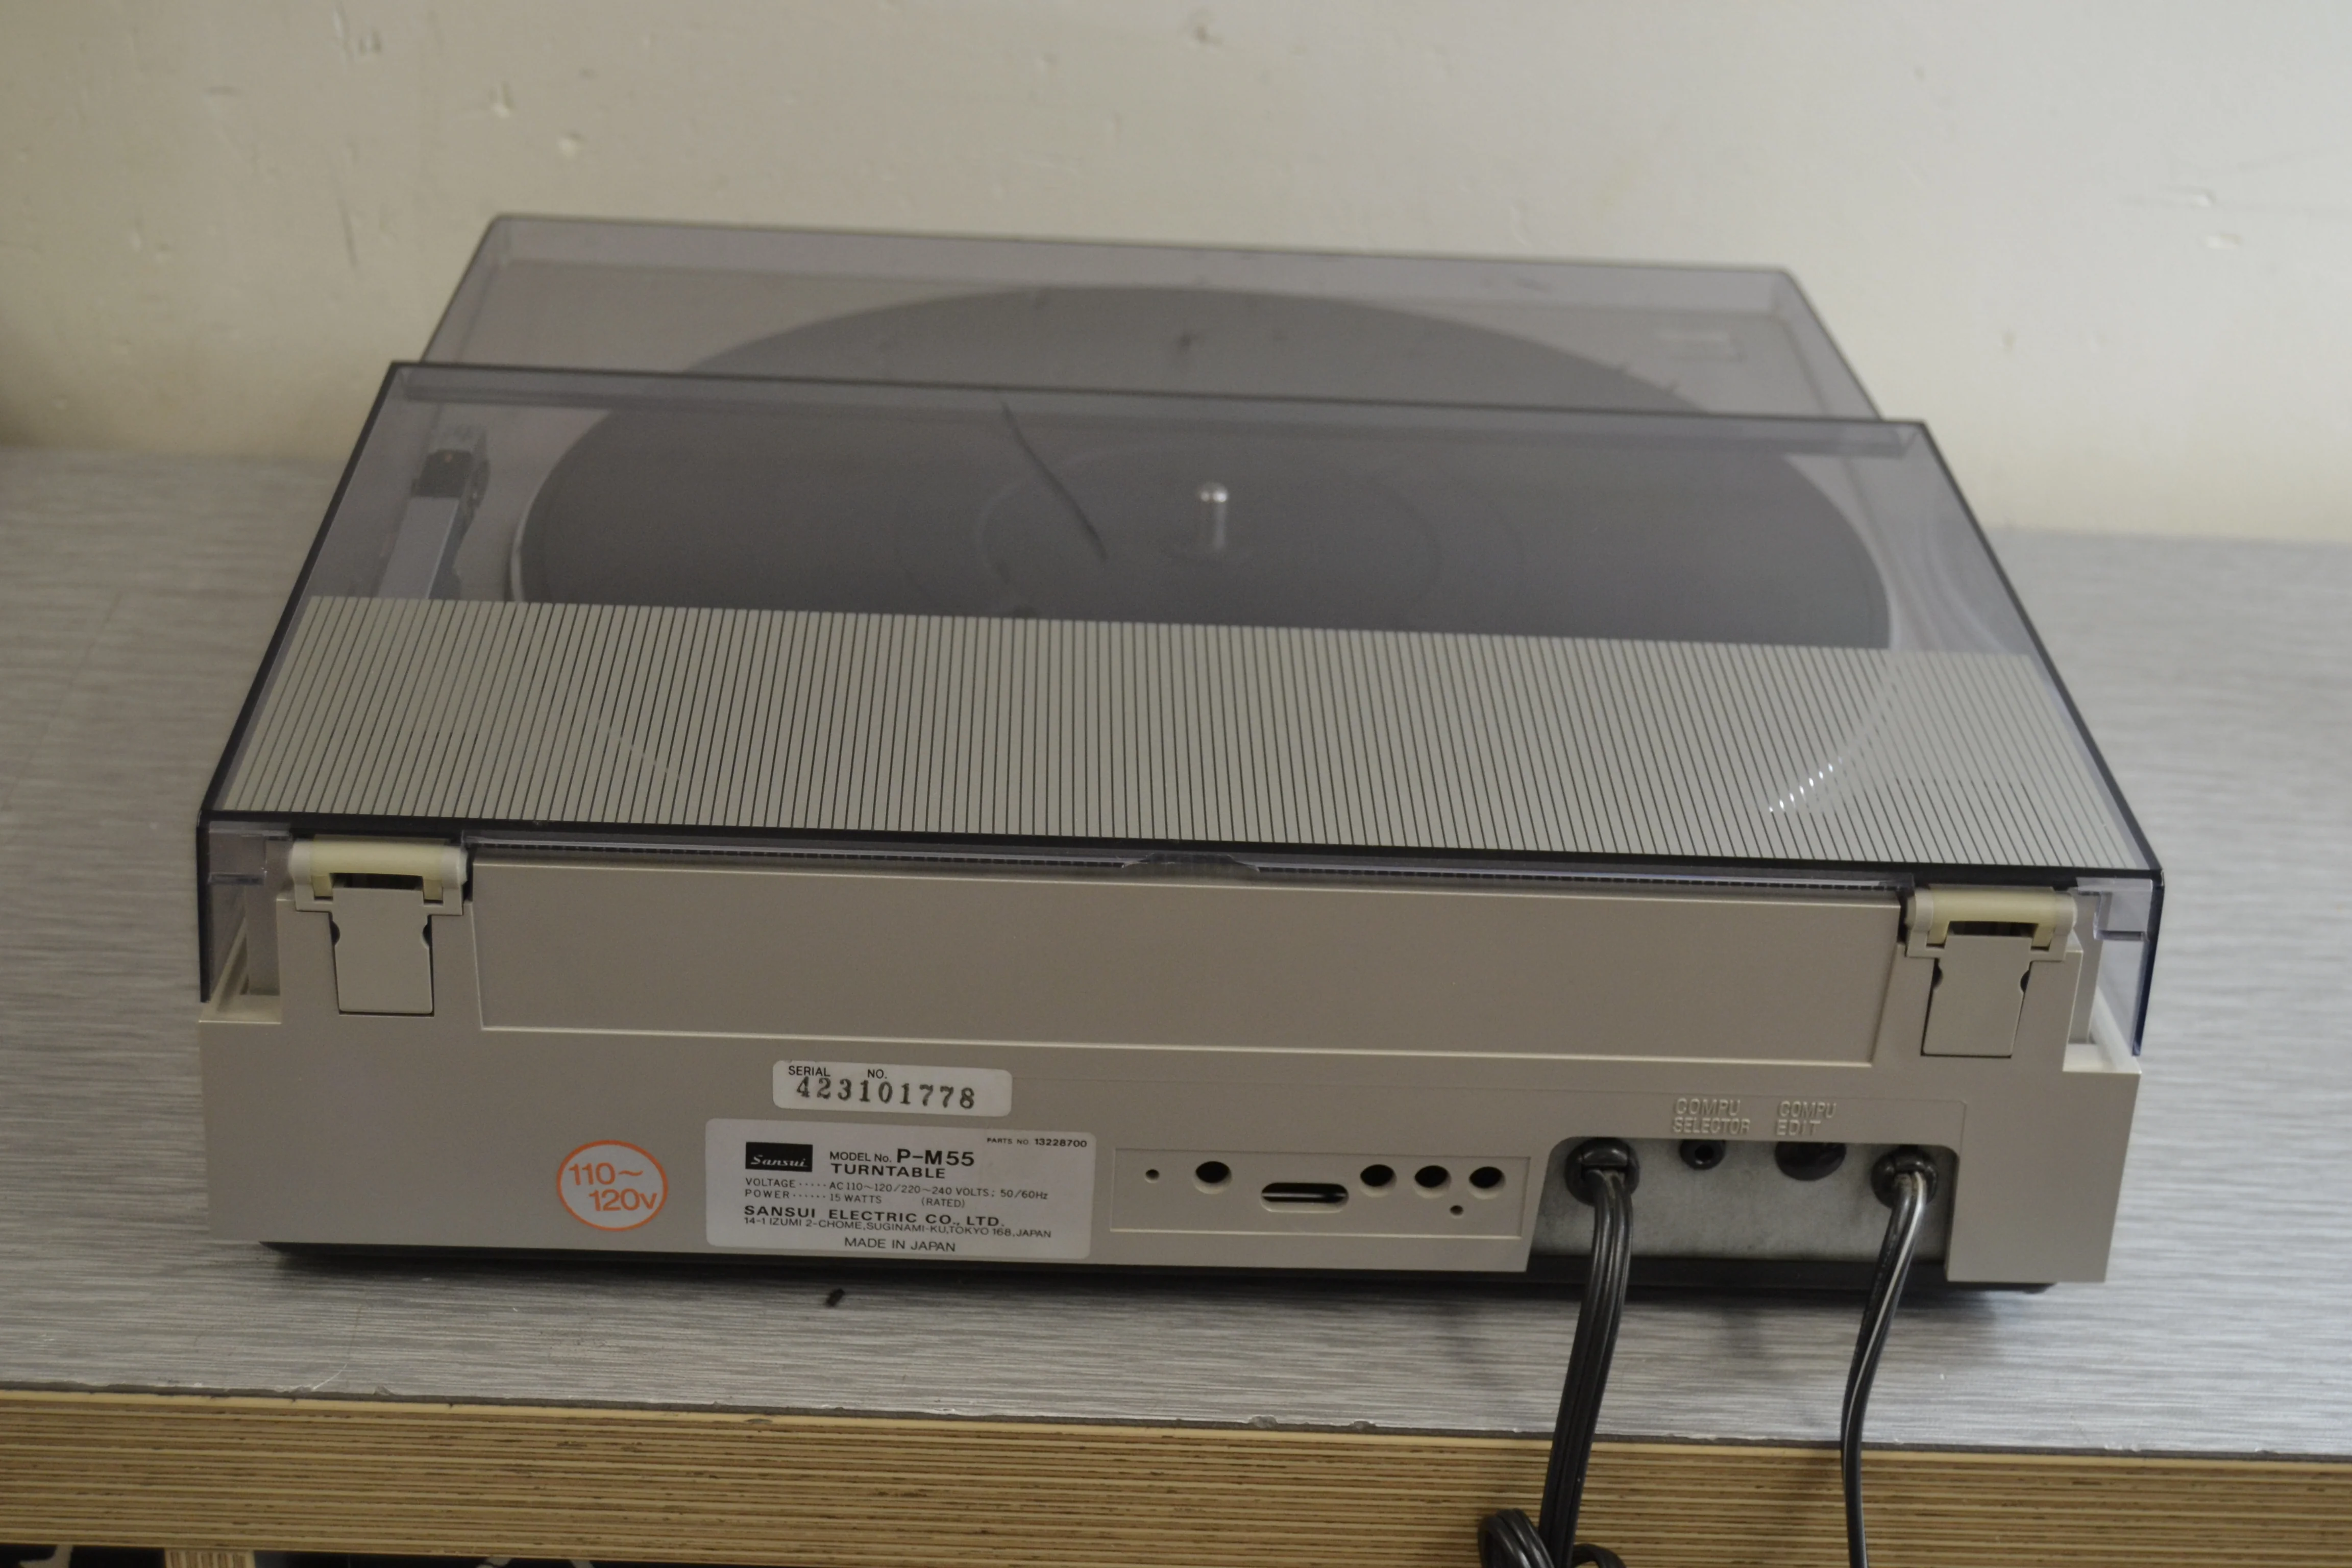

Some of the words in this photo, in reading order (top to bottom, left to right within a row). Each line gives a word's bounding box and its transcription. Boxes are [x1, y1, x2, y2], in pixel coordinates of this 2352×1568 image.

[789, 1066, 831, 1077] SERIAL
[868, 1069, 888, 1079] NO.
[797, 1076, 975, 1110] 423101778
[1675, 1098, 1741, 1117] COMPU
[1778, 1100, 1837, 1118] COMPU
[1673, 1116, 1751, 1134] SELECTOR
[1776, 1119, 1821, 1136] EDIT
[1035, 1138, 1087, 1148] 13228700
[750, 1154, 808, 1168] Sansui
[829, 1151, 871, 1162] MODEL
[874, 1153, 892, 1163] No.
[897, 1148, 975, 1167] P-M55
[830, 1163, 946, 1179] TURNTABLE
[830, 1193, 841, 1202] 15
[844, 1194, 883, 1204] WATTS
[1000, 1188, 1049, 1199] 50/60Hz
[921, 1197, 966, 1208] (RATED)
[744, 1205, 816, 1218] SANSUI
[829, 1209, 918, 1223] ELECTRIC
[966, 1215, 1005, 1227] LTD.
[744, 1217, 766, 1225] 14-1
[769, 1217, 802, 1227] IZUMI
[844, 1237, 887, 1249] MADE
[892, 1239, 905, 1250] IN
[911, 1240, 956, 1252] JAPAN
